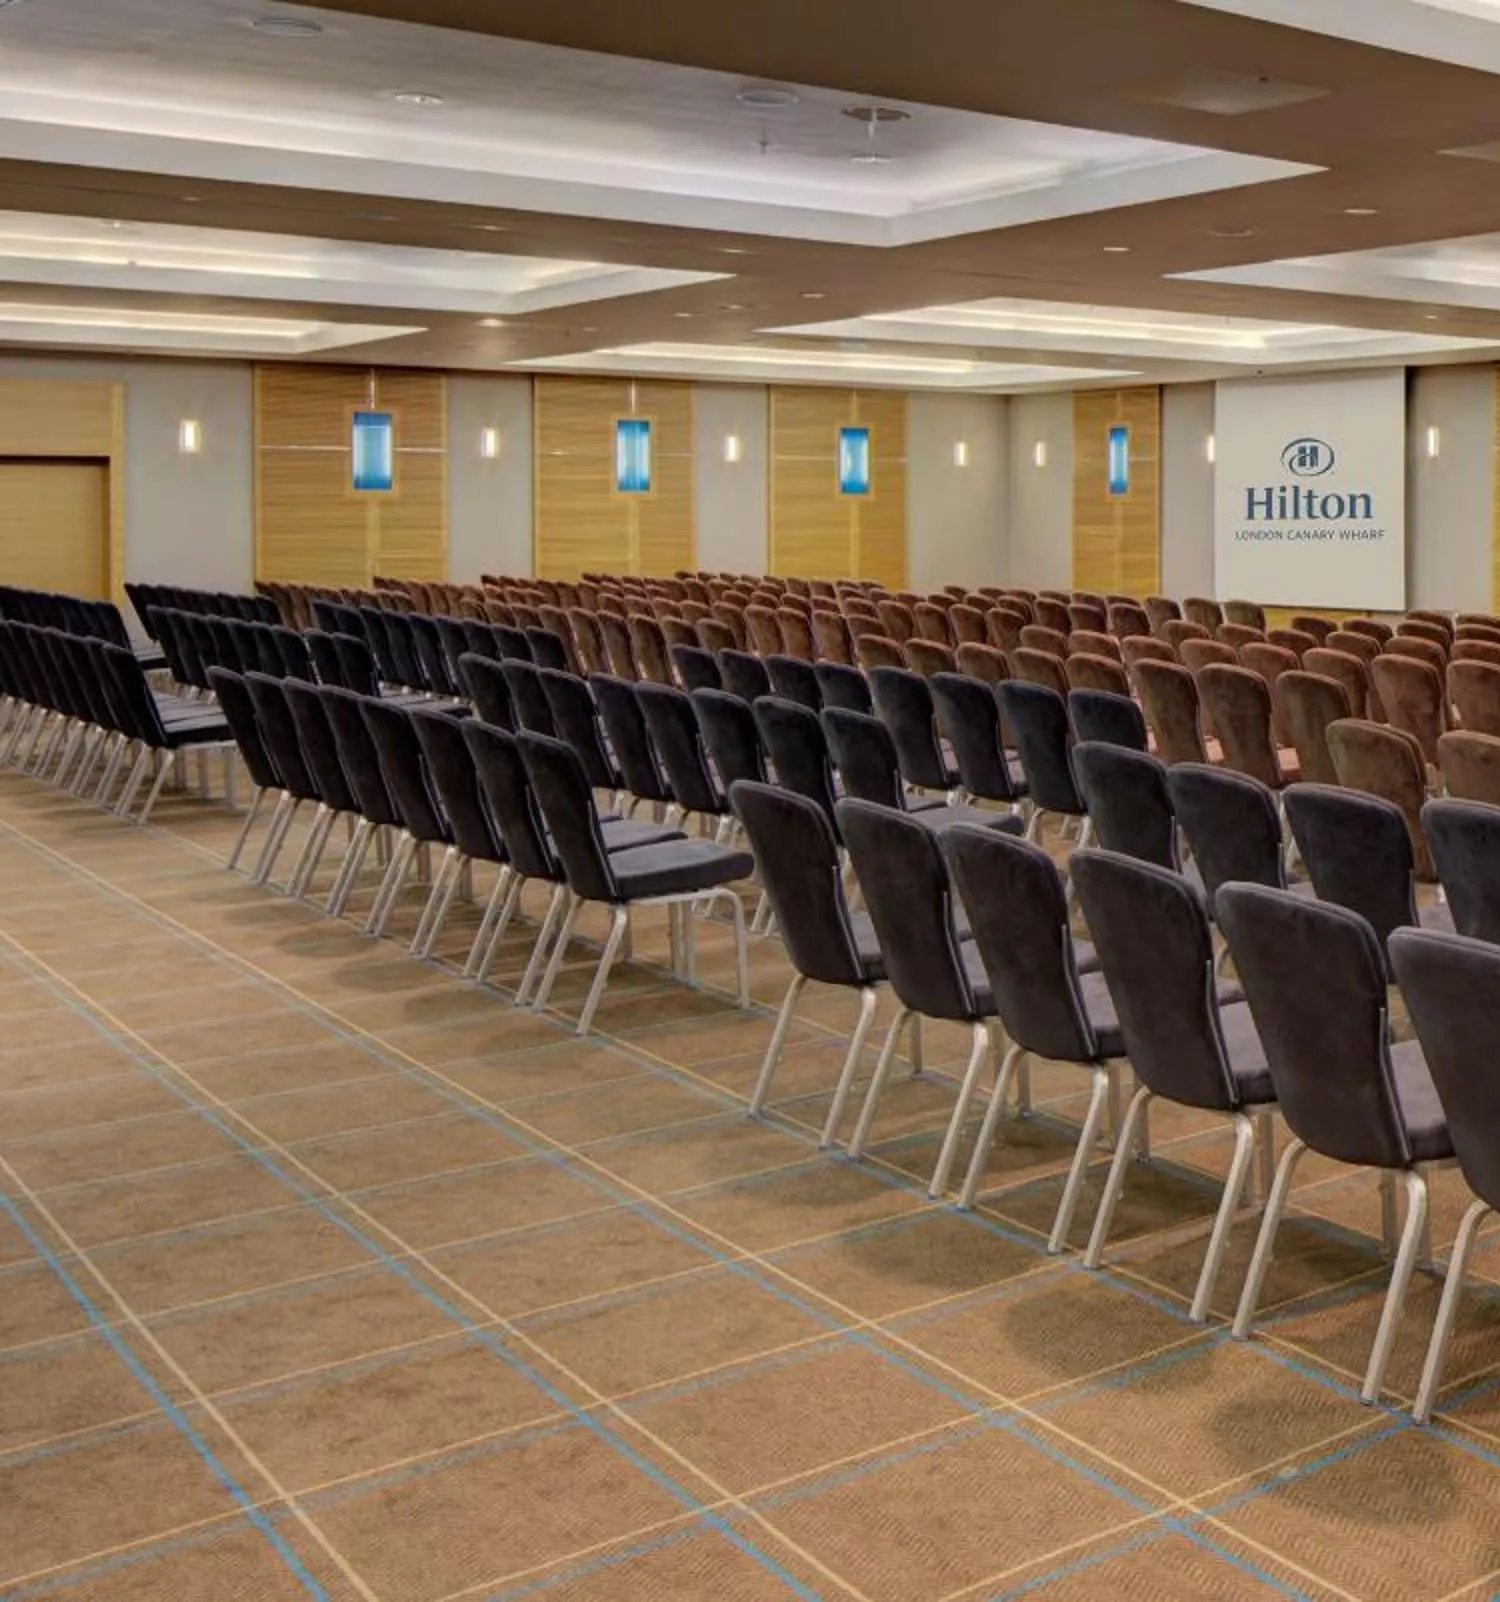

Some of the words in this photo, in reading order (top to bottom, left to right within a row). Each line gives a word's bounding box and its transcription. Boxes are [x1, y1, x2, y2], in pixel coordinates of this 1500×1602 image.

[1244, 484, 1374, 521] Hilton
[1234, 529, 1283, 541] LONDON
[1286, 529, 1335, 541] CANARY
[1339, 529, 1385, 541] WHARF
